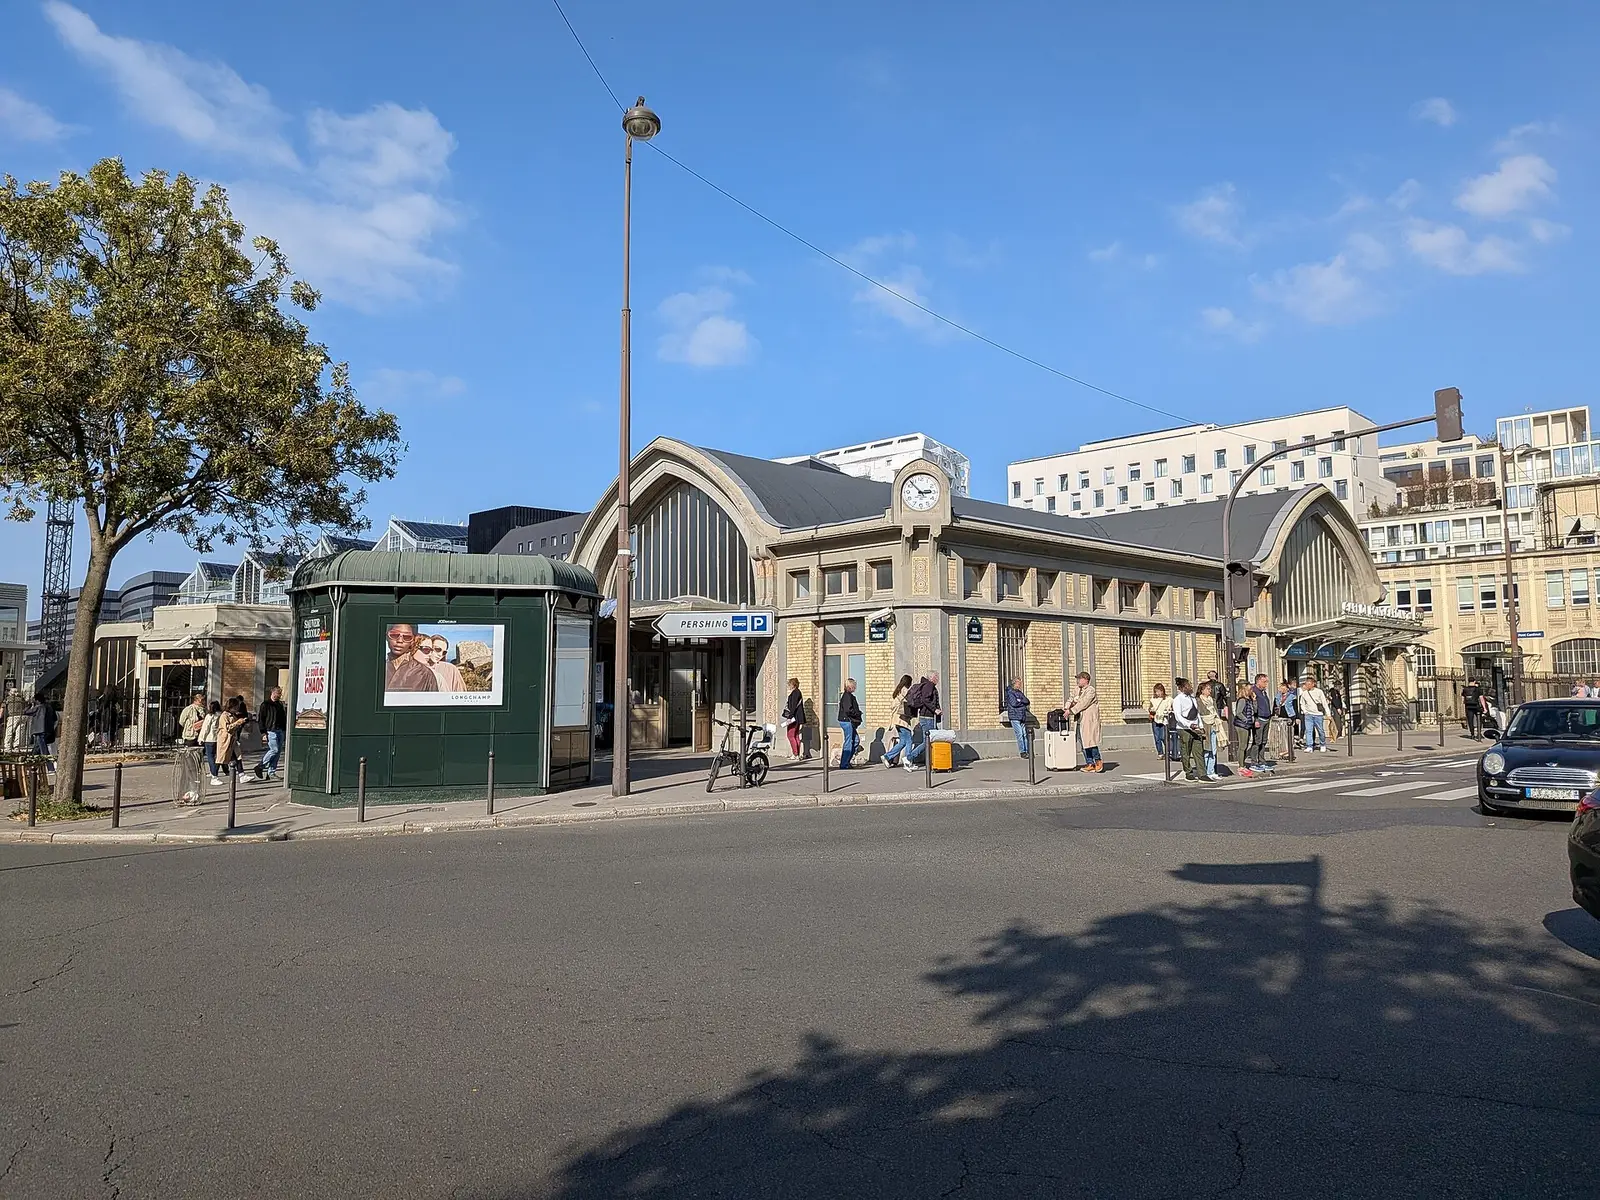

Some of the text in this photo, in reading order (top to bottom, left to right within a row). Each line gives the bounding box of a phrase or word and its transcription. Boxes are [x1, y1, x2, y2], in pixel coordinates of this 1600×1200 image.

[680, 617, 763, 630] PERSHING P
[304, 678, 324, 694] CHAOS
